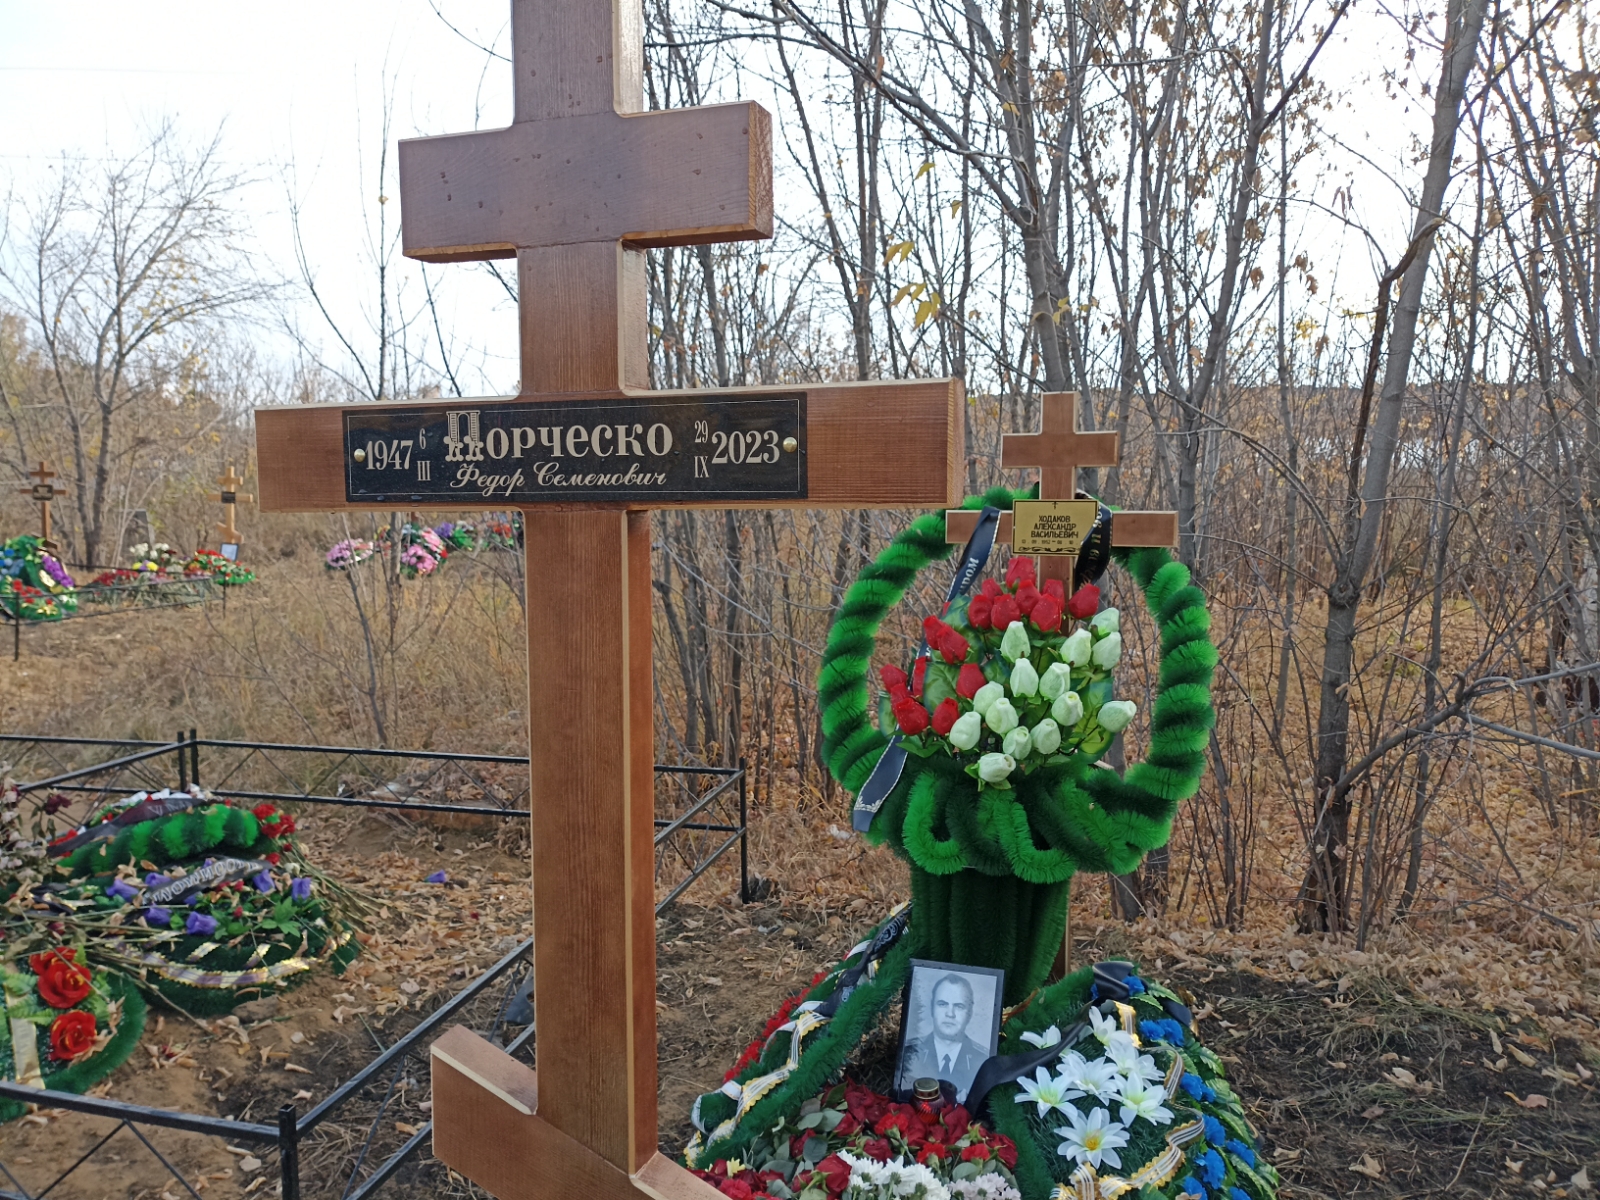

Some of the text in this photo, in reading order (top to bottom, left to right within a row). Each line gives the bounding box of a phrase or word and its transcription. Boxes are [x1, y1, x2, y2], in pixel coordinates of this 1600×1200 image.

[419, 428, 427, 450] 6
[443, 410, 673, 462] Порческо
[694, 420, 709, 443] 29
[365, 440, 414, 471] 1947
[711, 430, 780, 464] 2023
[450, 461, 667, 497] Федор Семенович
[1033, 523, 1077, 532] АЛЕКСАНДР
[1038, 515, 1071, 524] ХОДАКОВ
[1030, 531, 1079, 539] ВАСИЛЬЕВИЧ
